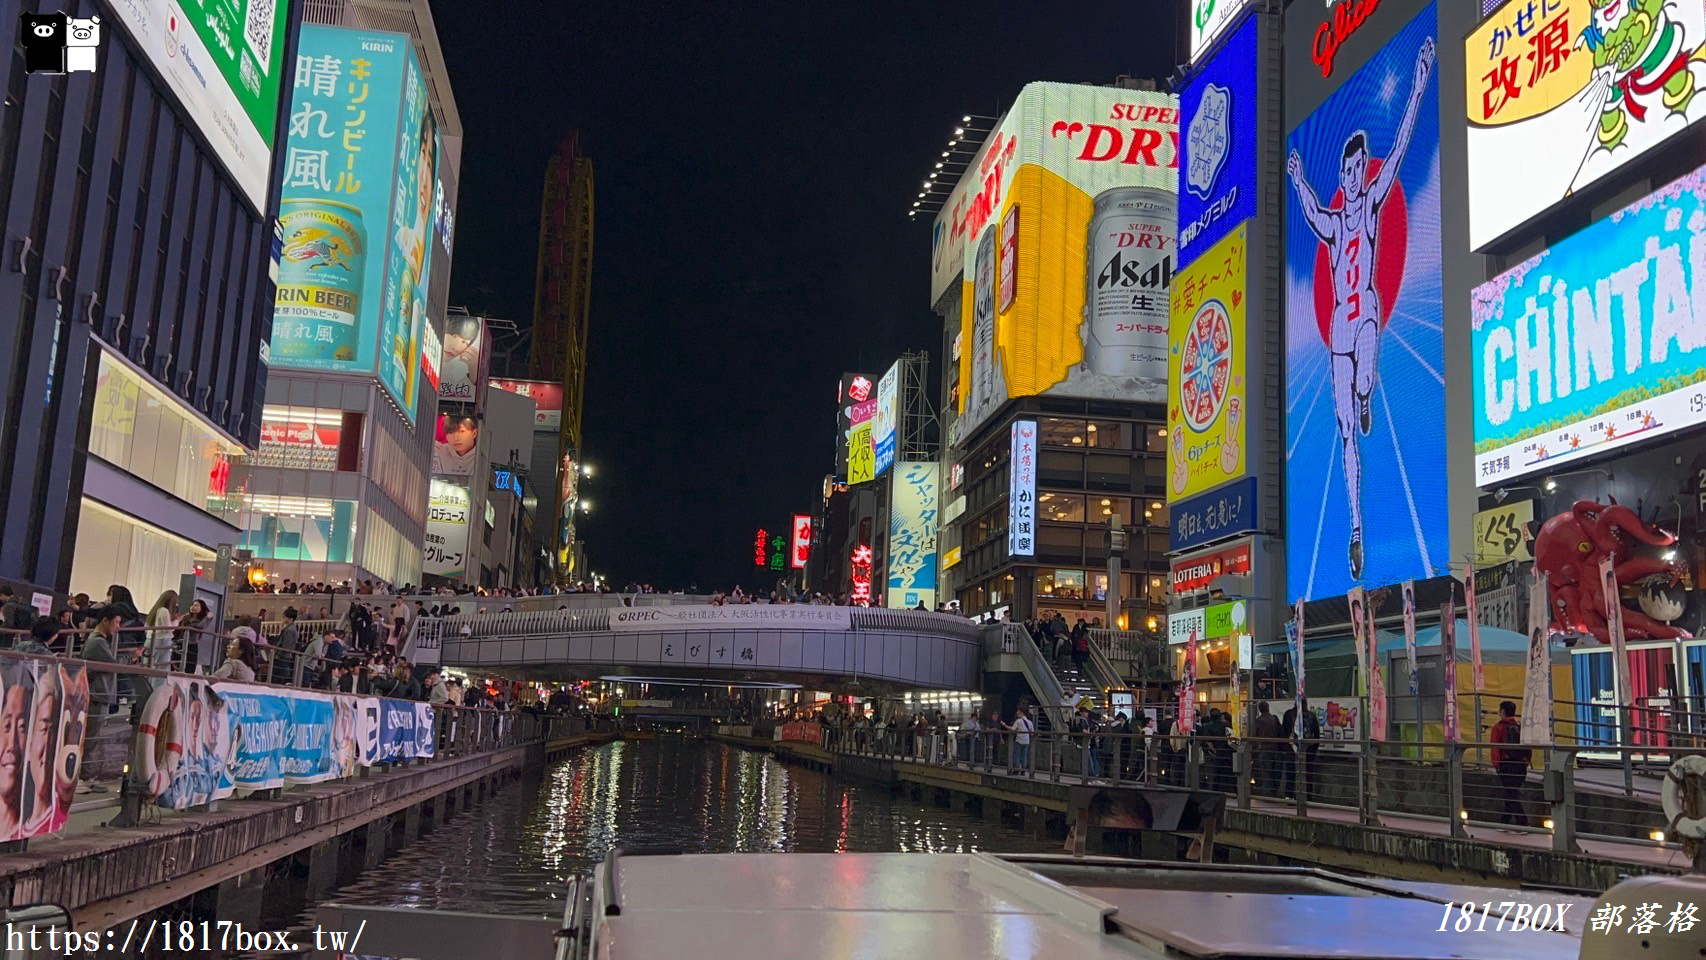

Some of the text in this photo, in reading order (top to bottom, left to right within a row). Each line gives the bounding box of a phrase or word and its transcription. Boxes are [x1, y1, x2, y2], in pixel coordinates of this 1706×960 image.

[361, 41, 394, 53] KIRIN
[1481, 7, 1571, 120] 改源
[282, 54, 342, 192] 晴れ風
[335, 57, 372, 194] キリンビール
[296, 211, 346, 229] ORIGINAL
[1128, 223, 1162, 233] SUPER
[1180, 185, 1237, 250] 雪印メグミルク
[1346, 230, 1361, 323] グリコ
[315, 290, 352, 309] BEER
[1132, 295, 1154, 311] 生
[273, 322, 334, 343] 晴れ風
[1626, 410, 1642, 421] 18時
[1559, 433, 1569, 443] 6時
[1590, 422, 1604, 433] 12時
[861, 428, 872, 479] 高収入
[1188, 433, 1221, 462] 6pチーズ
[1020, 442, 1032, 485] 本場の味
[1482, 455, 1510, 477] 天気予報
[905, 464, 937, 552] シャッターは
[1018, 489, 1032, 551] かに道楽
[1485, 512, 1522, 556] くくる
[424, 545, 464, 567] グループ
[1174, 563, 1212, 584] LOTTERIA
[664, 643, 753, 661] えびす橋
